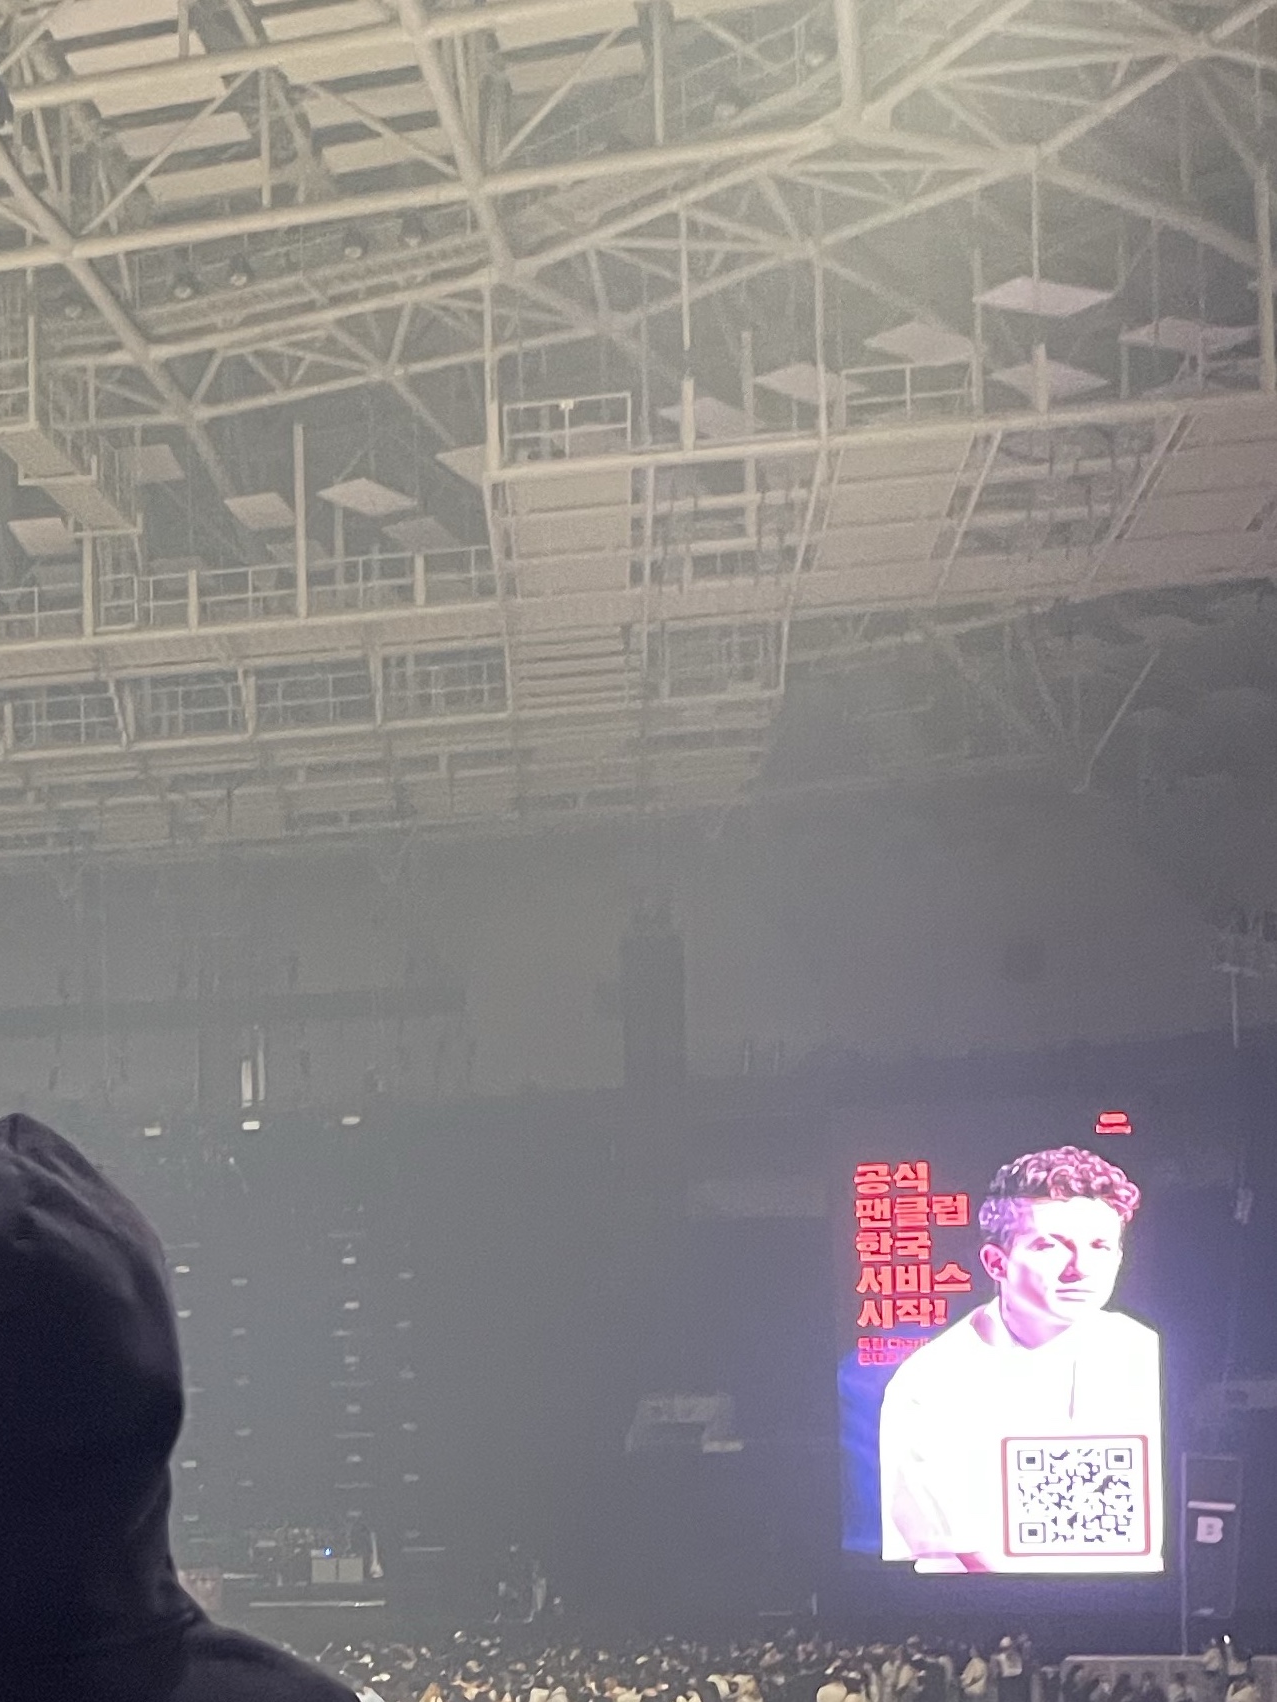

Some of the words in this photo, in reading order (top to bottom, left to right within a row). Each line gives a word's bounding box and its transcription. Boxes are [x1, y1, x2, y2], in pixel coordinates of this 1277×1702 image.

[853, 1160, 929, 1194] 공식
[855, 1193, 970, 1228] 팬클럽
[855, 1230, 932, 1262] 한국
[855, 1263, 972, 1295] 서비스
[856, 1297, 947, 1329] 시작!
